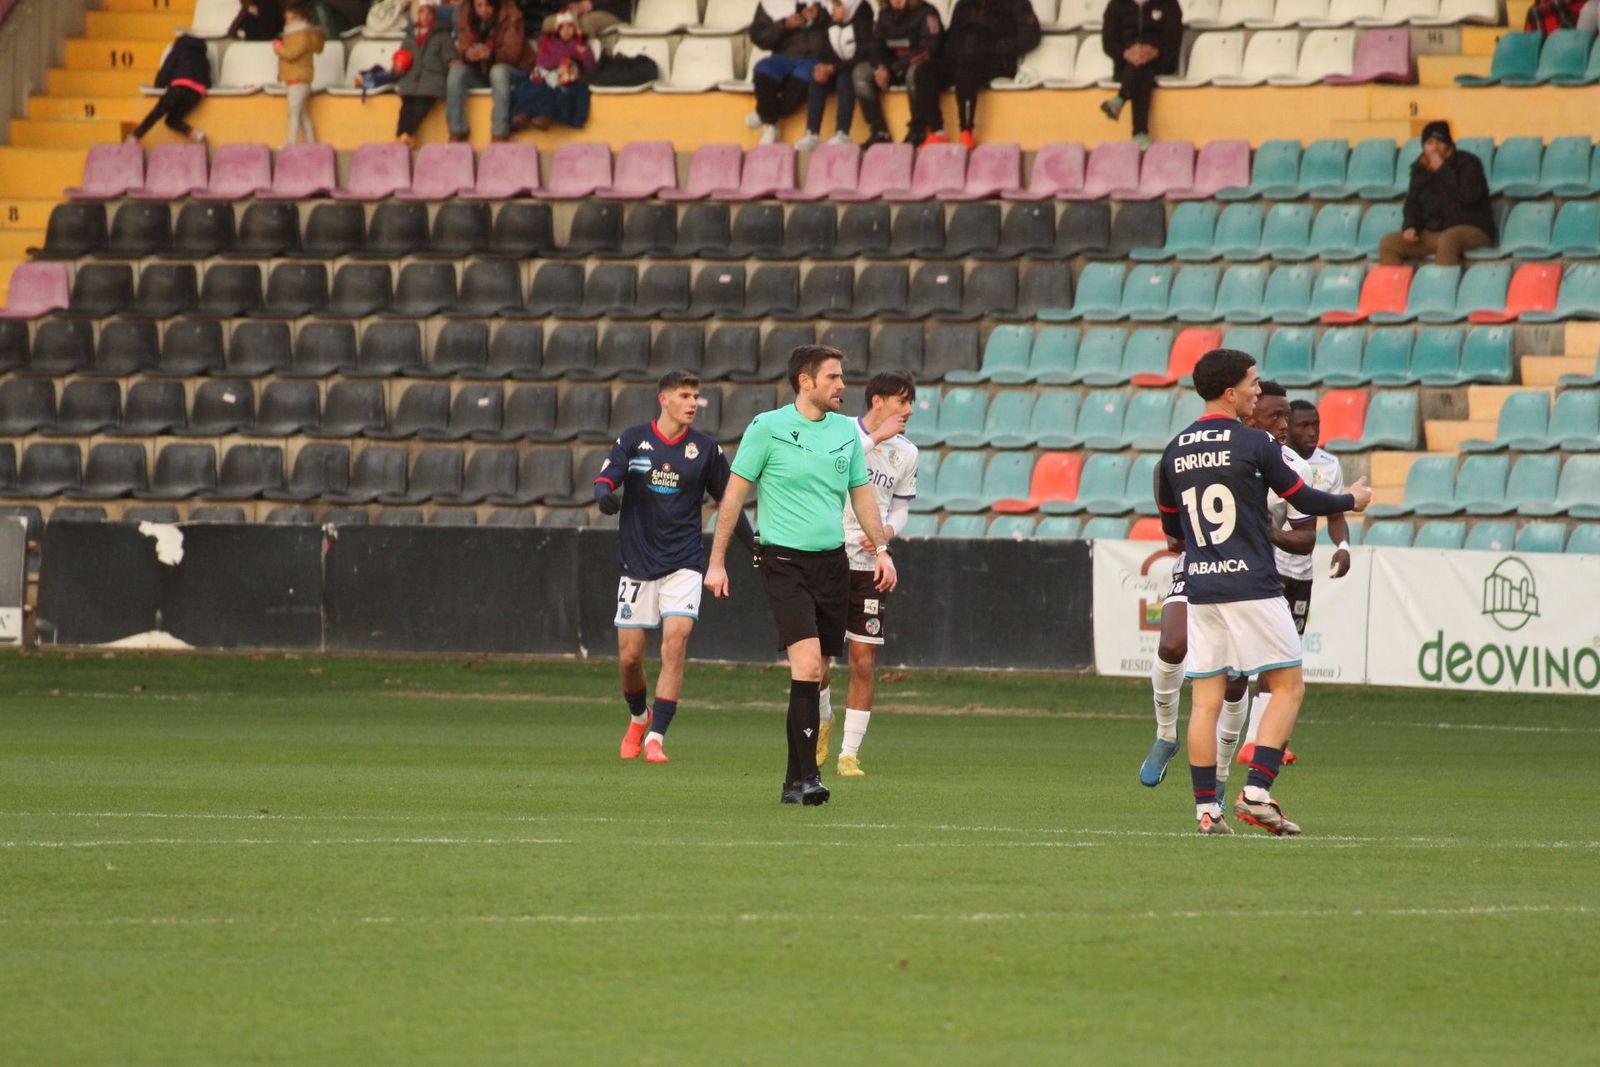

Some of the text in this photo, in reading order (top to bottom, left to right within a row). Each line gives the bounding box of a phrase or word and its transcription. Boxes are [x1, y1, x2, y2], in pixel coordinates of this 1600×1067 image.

[109, 50, 134, 68] 10
[85, 103, 95, 118] 9
[9, 206, 19, 222] 8
[1178, 429, 1231, 446] DIGI
[1174, 450, 1231, 473] ENRIQUE
[651, 469, 679, 480] Estrella
[651, 477, 677, 487] Galicia
[1181, 483, 1236, 547] 19
[1188, 559, 1249, 576] ABANCA
[619, 581, 641, 603] 27
